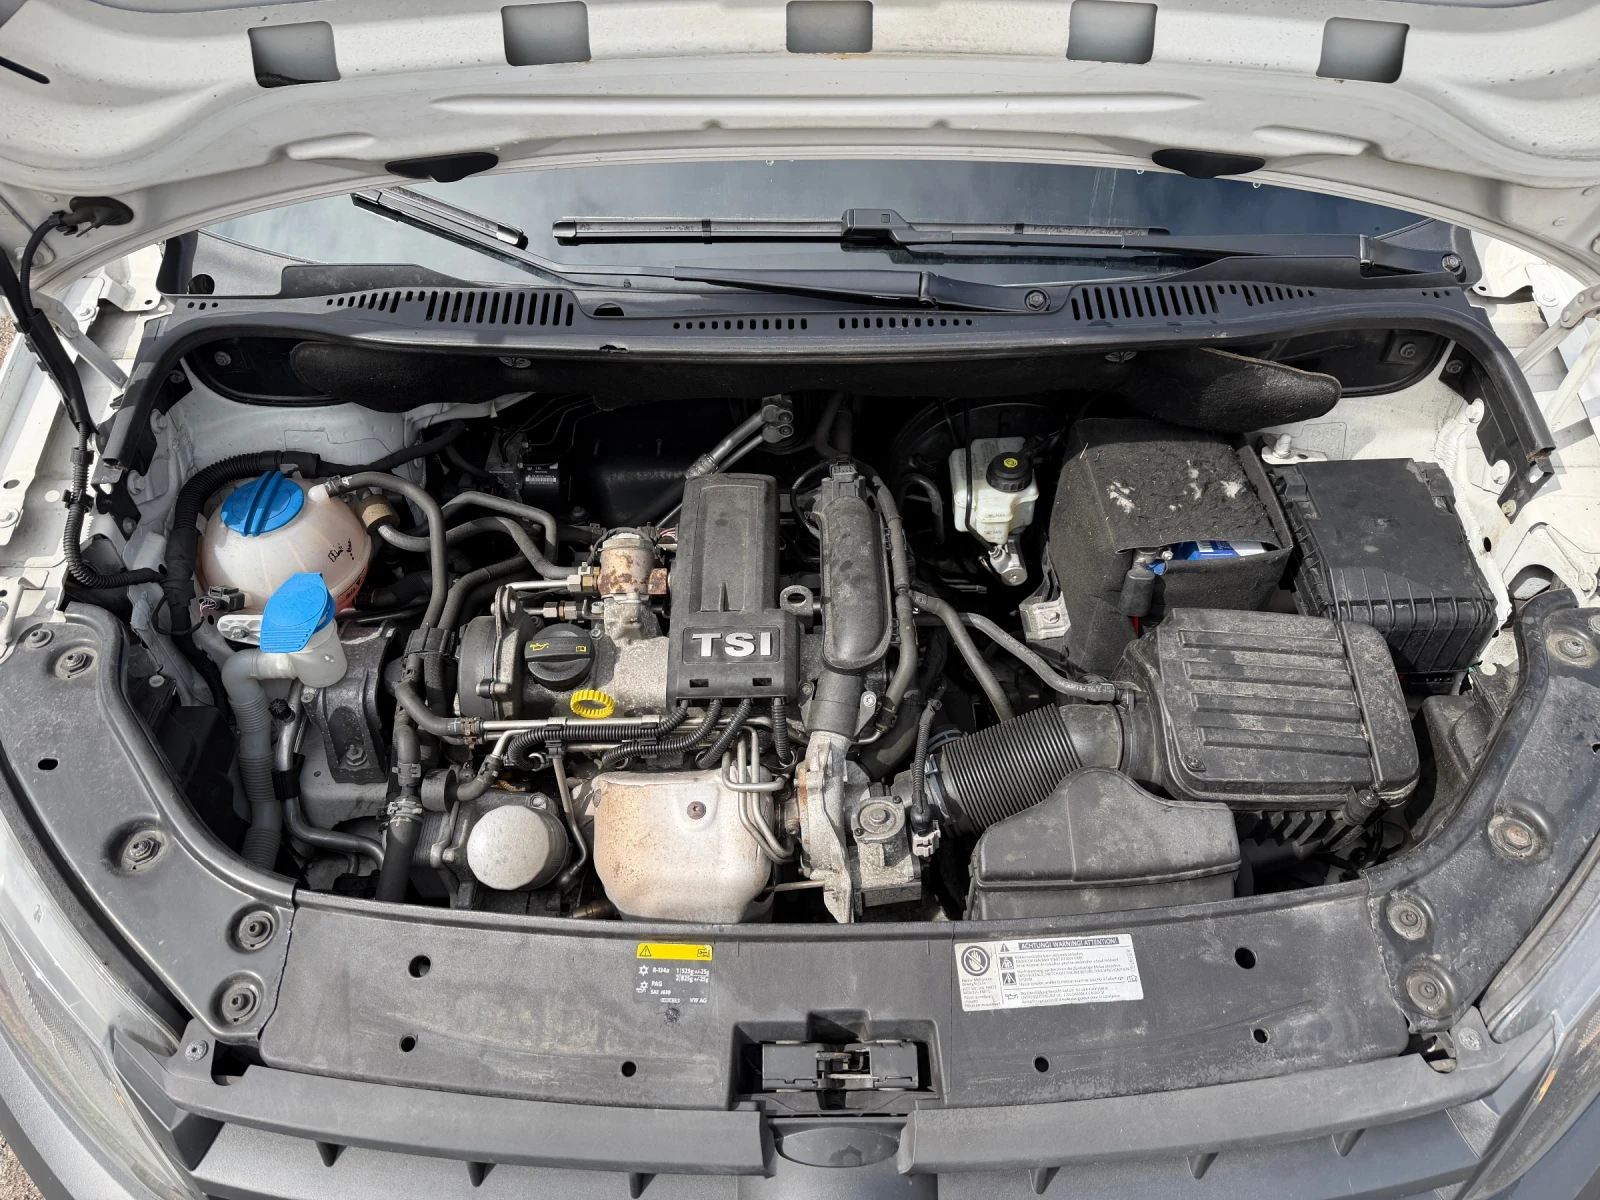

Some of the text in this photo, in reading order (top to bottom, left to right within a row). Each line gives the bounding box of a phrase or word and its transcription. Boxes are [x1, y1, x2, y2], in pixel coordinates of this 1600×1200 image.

[692, 631, 772, 657] TSI
[1021, 938, 1118, 950] ACHTUNG! WARNING! ATTENTION!
